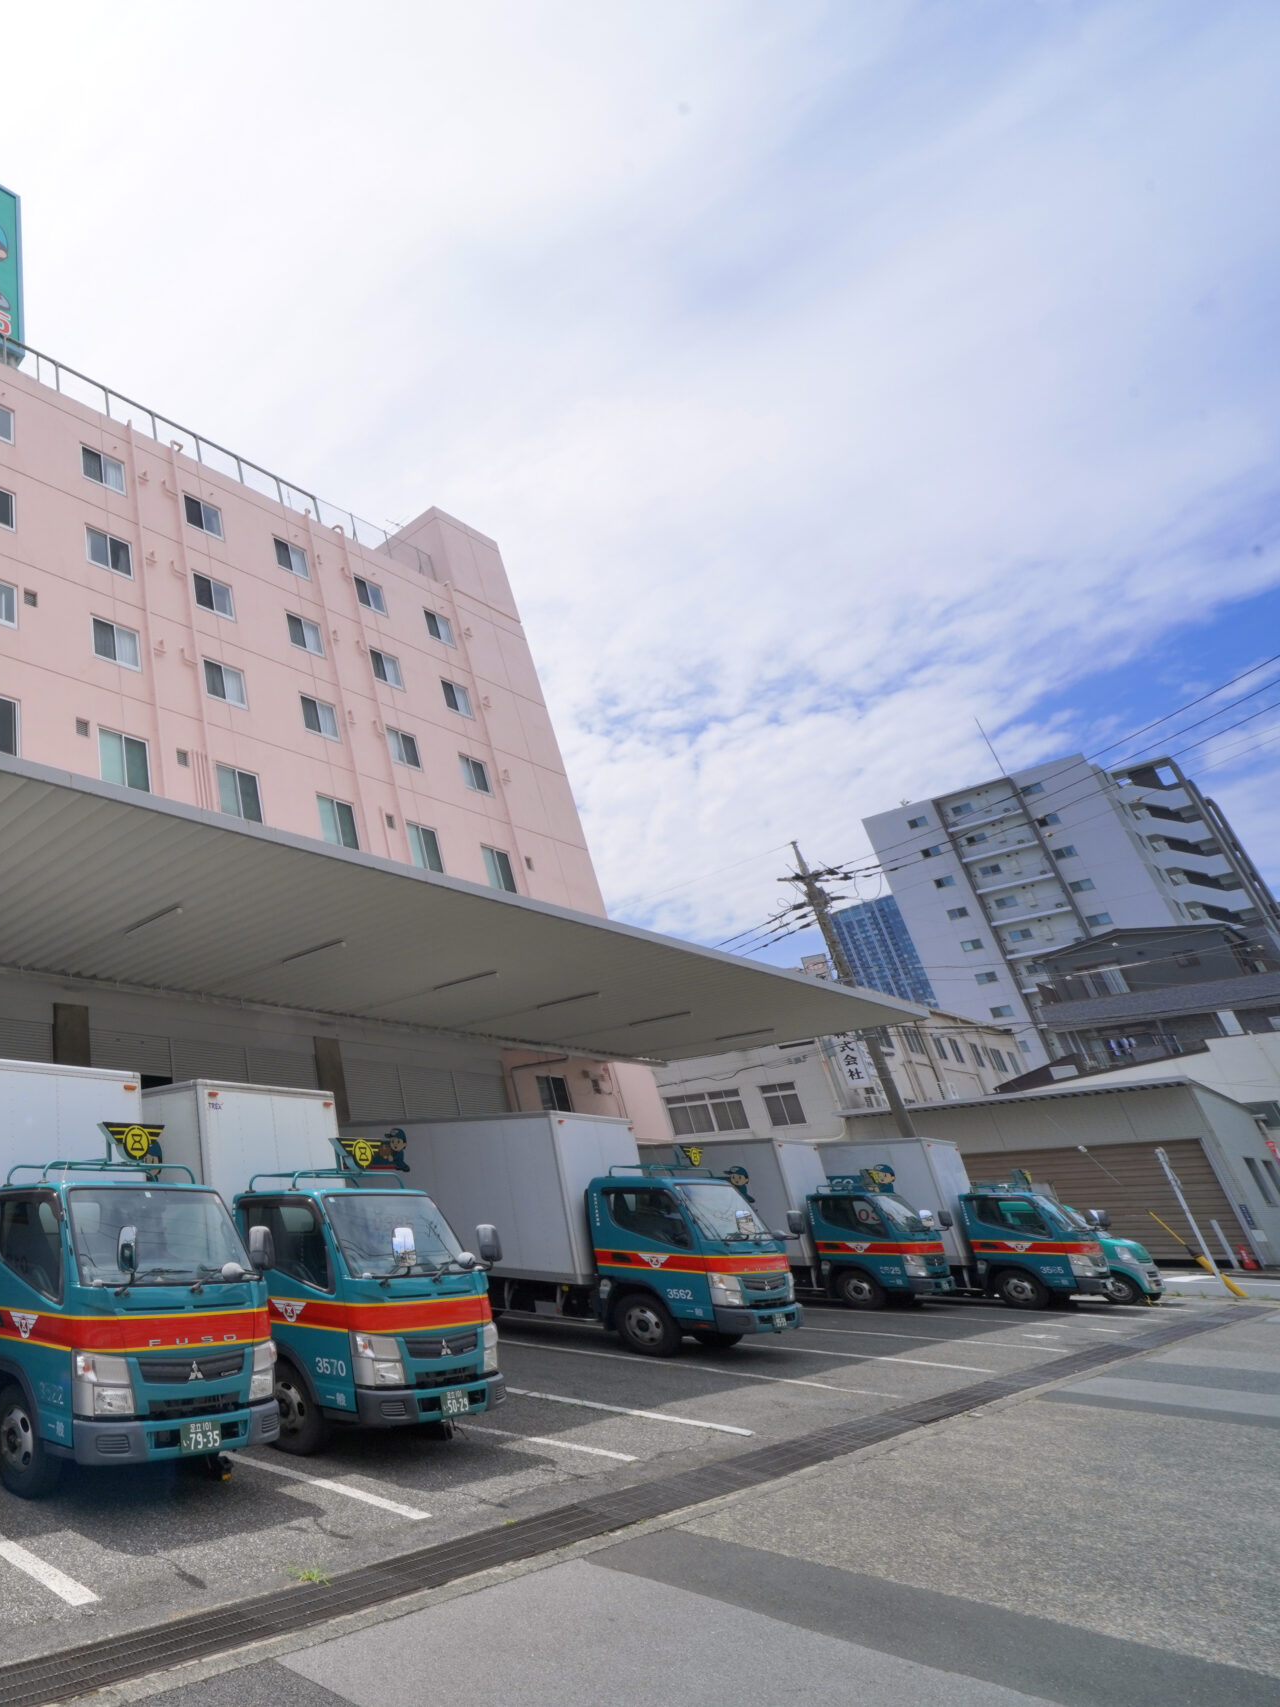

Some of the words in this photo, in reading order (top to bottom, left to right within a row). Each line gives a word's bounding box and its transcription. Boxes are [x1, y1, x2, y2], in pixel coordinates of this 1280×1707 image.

[666, 1288, 693, 1300] 3562
[148, 1333, 237, 1347] FUSO
[315, 1356, 347, 1377] 3570
[189, 1430, 220, 1450] 79-35
